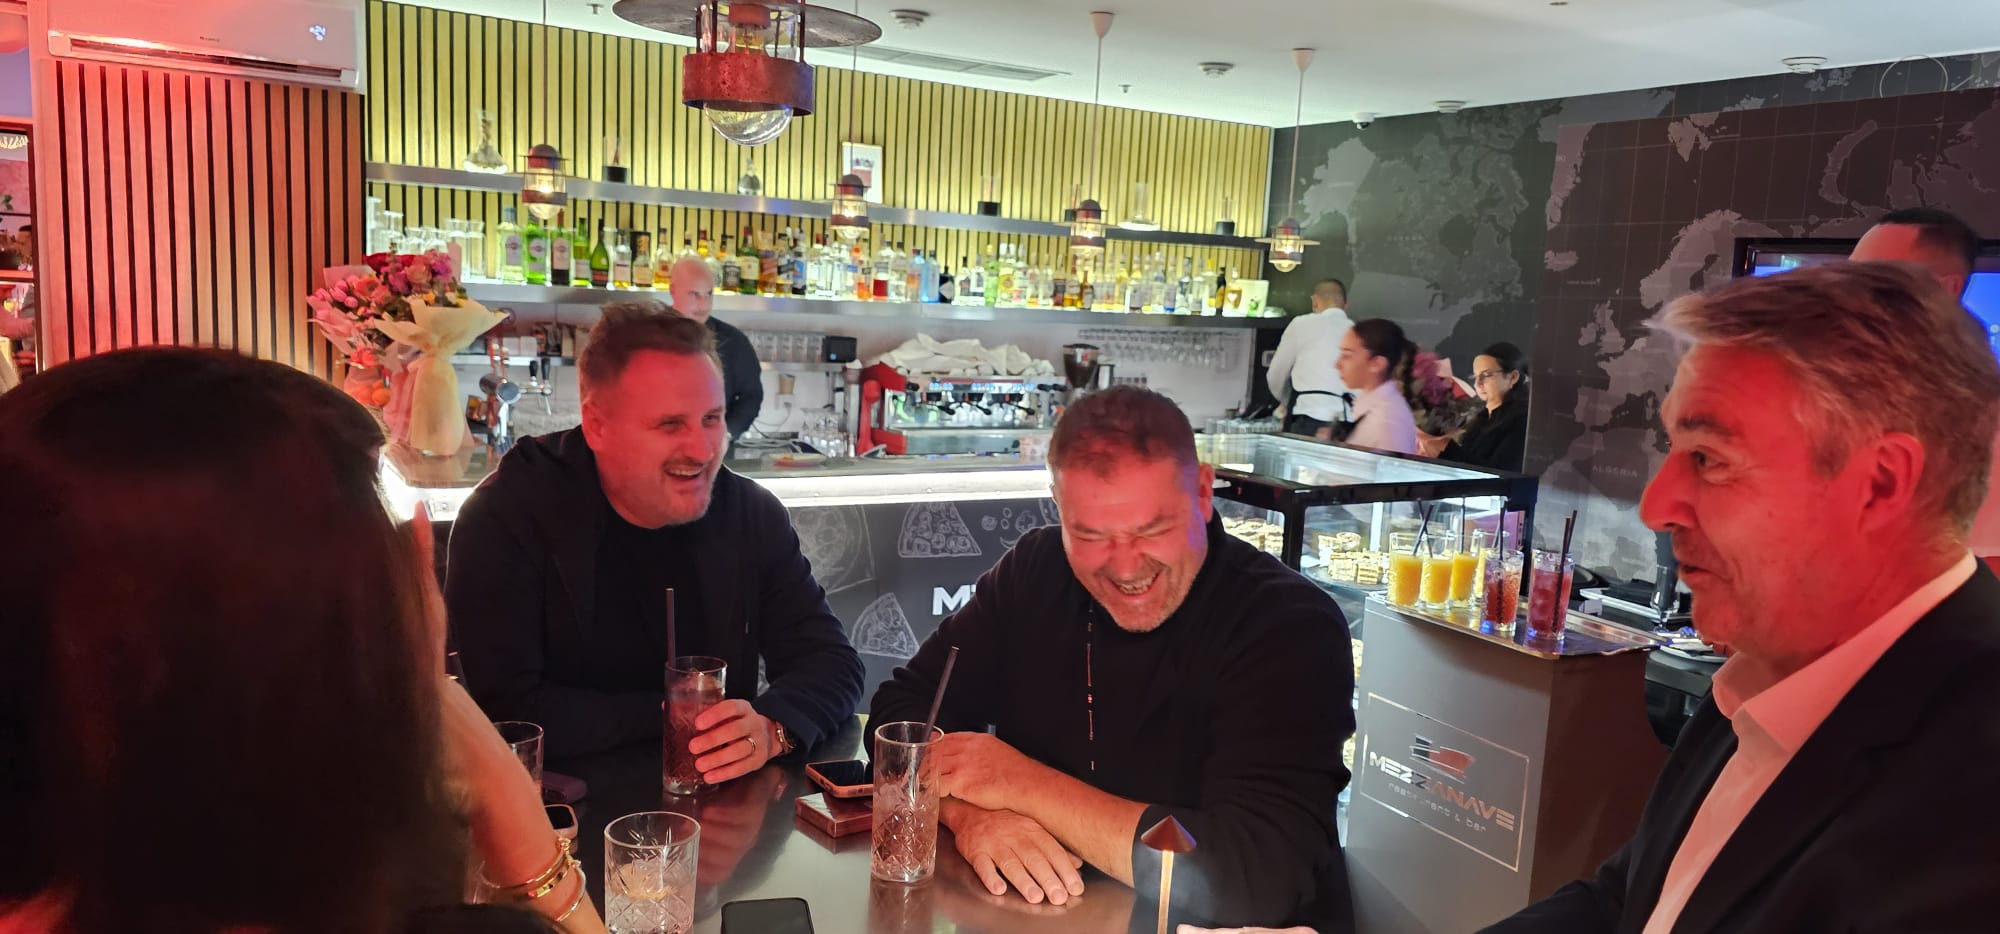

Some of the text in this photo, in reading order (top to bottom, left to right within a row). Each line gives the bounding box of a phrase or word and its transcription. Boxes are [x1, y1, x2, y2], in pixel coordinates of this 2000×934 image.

[1592, 464, 1638, 478] ALGERIA
[932, 584, 976, 616] M
[1369, 751, 1515, 832] MEZZANAVE
[1387, 782, 1451, 817] restrant
[1466, 817, 1487, 833] bar
